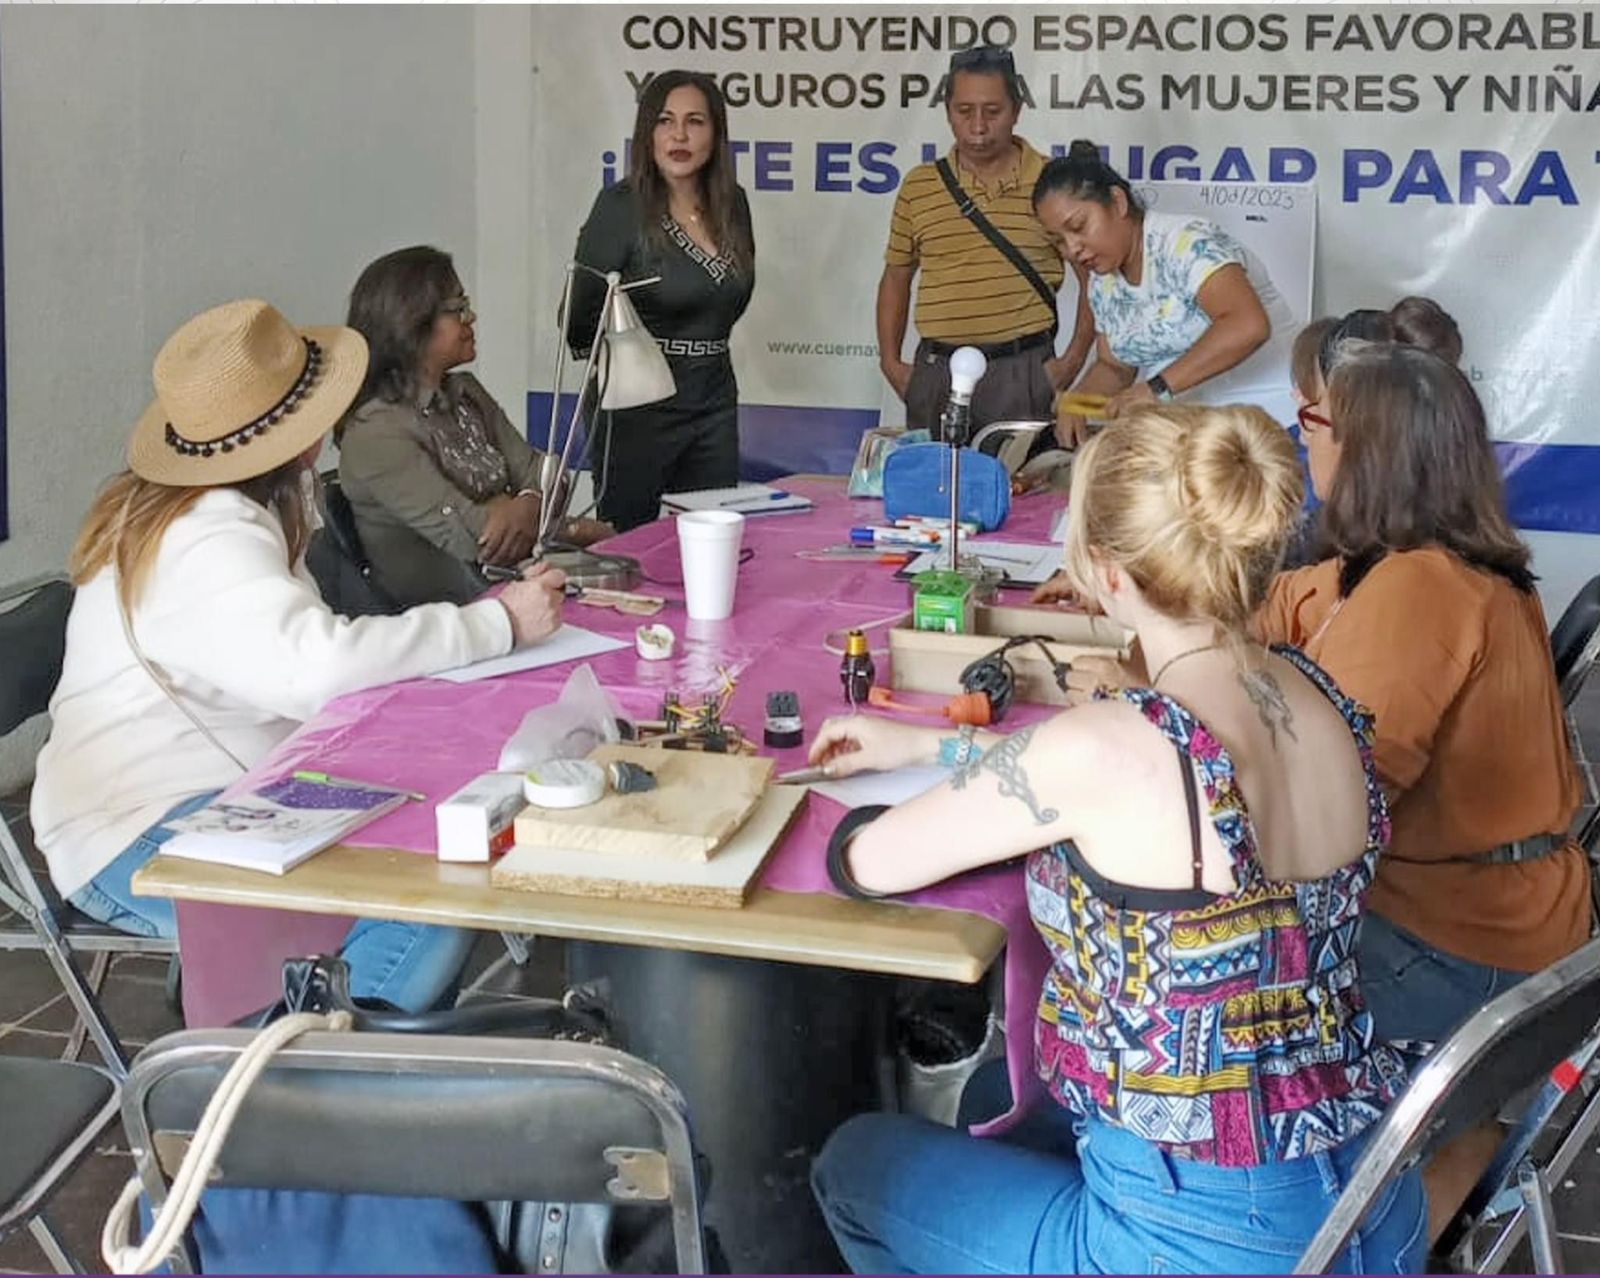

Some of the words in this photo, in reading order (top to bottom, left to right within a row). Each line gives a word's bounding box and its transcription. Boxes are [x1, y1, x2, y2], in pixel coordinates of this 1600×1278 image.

[623, 15, 1017, 51] CONSTRUYENDO
[1034, 14, 1288, 51] ESPACIOS
[1306, 13, 1600, 51] FAVORABL
[625, 71, 655, 104] Y
[700, 72, 886, 109] GUROS
[1050, 73, 1144, 110] LAS
[1161, 74, 1419, 112] MUJERES
[1433, 75, 1470, 112] Y
[815, 142, 901, 195] ES
[1343, 149, 1579, 205] PARA
